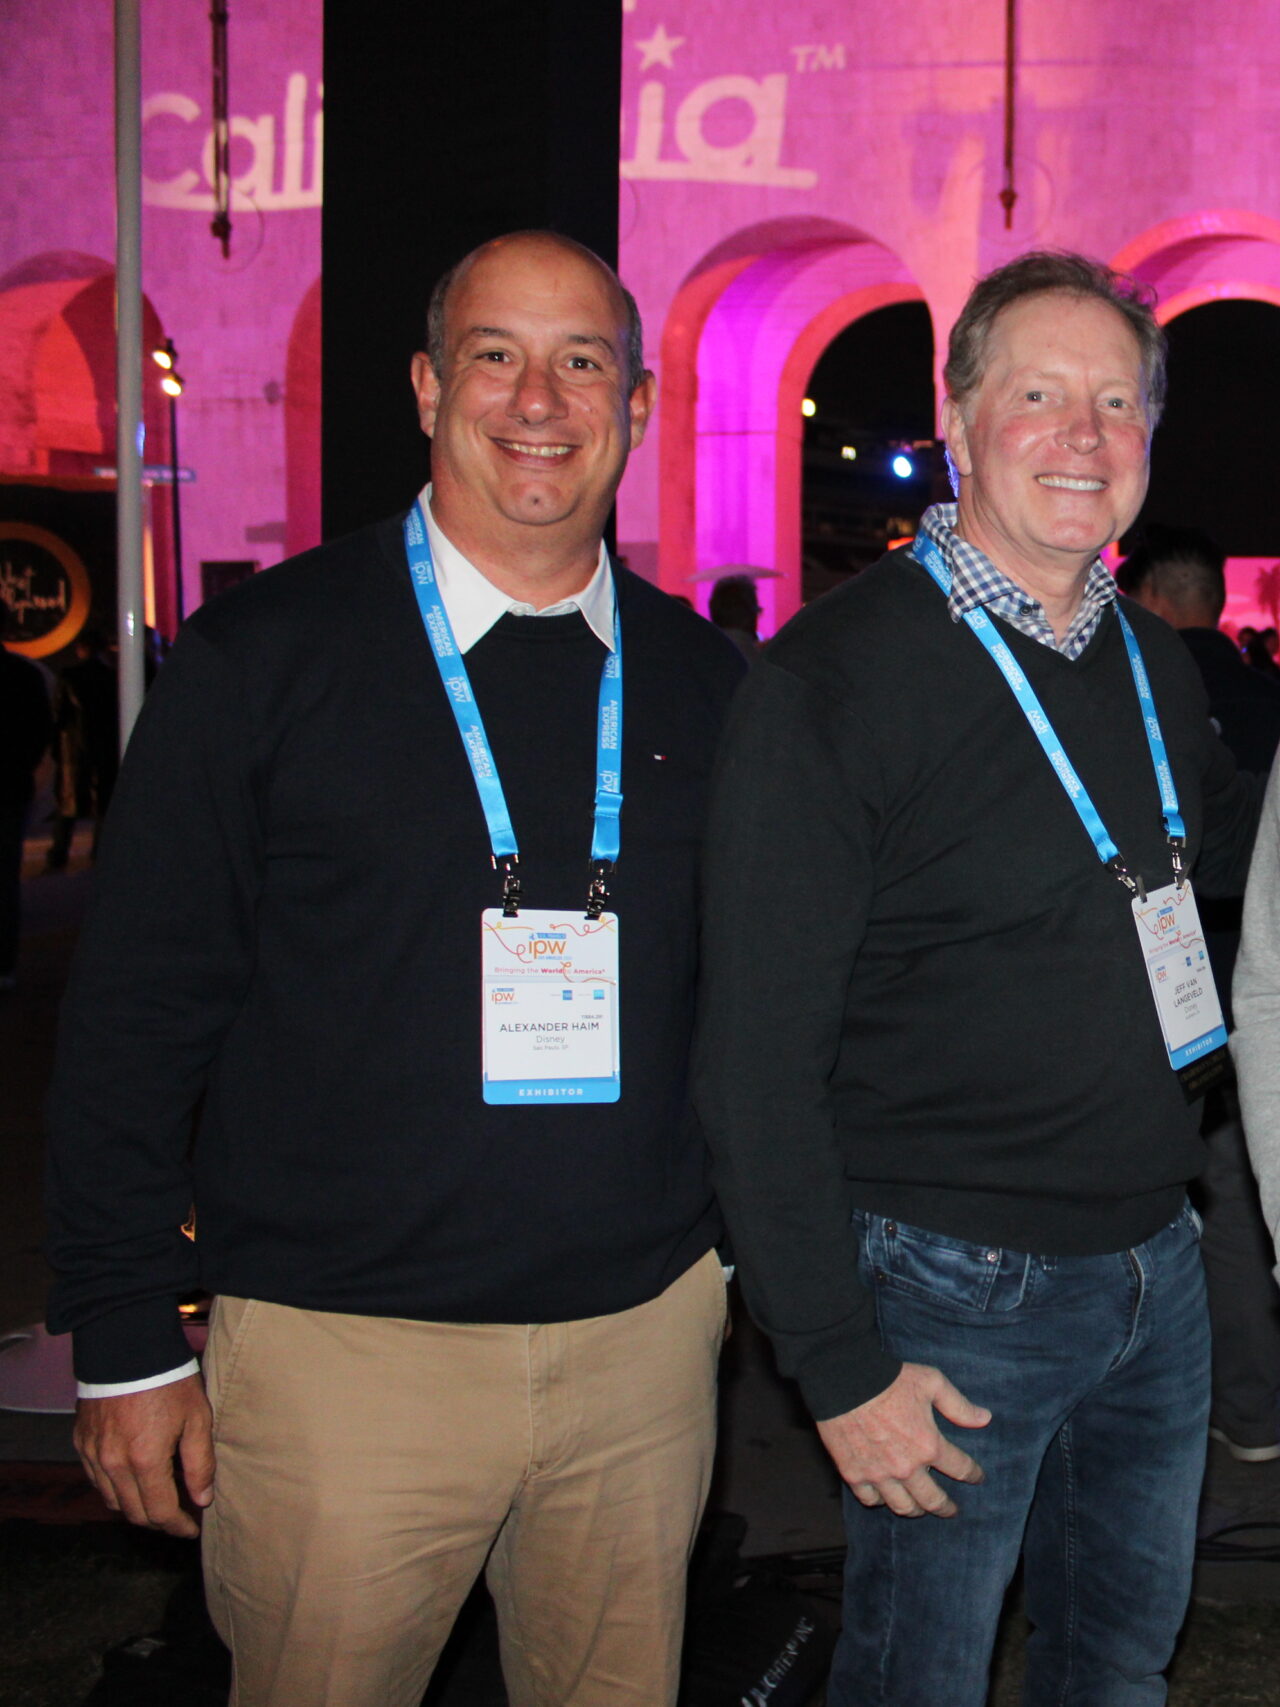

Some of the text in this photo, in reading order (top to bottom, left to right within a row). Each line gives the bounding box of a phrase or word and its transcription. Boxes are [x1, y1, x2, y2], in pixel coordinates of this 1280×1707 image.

[789, 42, 846, 72] TM
[426, 613, 443, 657] EXPRESS
[431, 604, 455, 656] AMERICAN
[991, 645, 1021, 691] AMERICAN
[997, 643, 1024, 683] EXPRESS
[444, 676, 466, 702] ipw
[601, 706, 610, 749] EXPRESS
[609, 700, 619, 750] AMERICAN
[464, 732, 483, 778] EXPRESS
[470, 724, 493, 777] AMERICAN
[1056, 750, 1081, 791] EXPRESS
[1051, 752, 1078, 798] AMERICAN
[529, 940, 567, 960] ipw
[491, 992, 515, 1004] ipw
[1174, 987, 1203, 1008] LANGEVELD
[1175, 978, 1198, 995] JEFF VAN
[499, 1022, 600, 1032] ALEXANDER HAIM
[536, 1035, 565, 1044] Disney
[518, 1088, 584, 1097] EXHIBITOR
